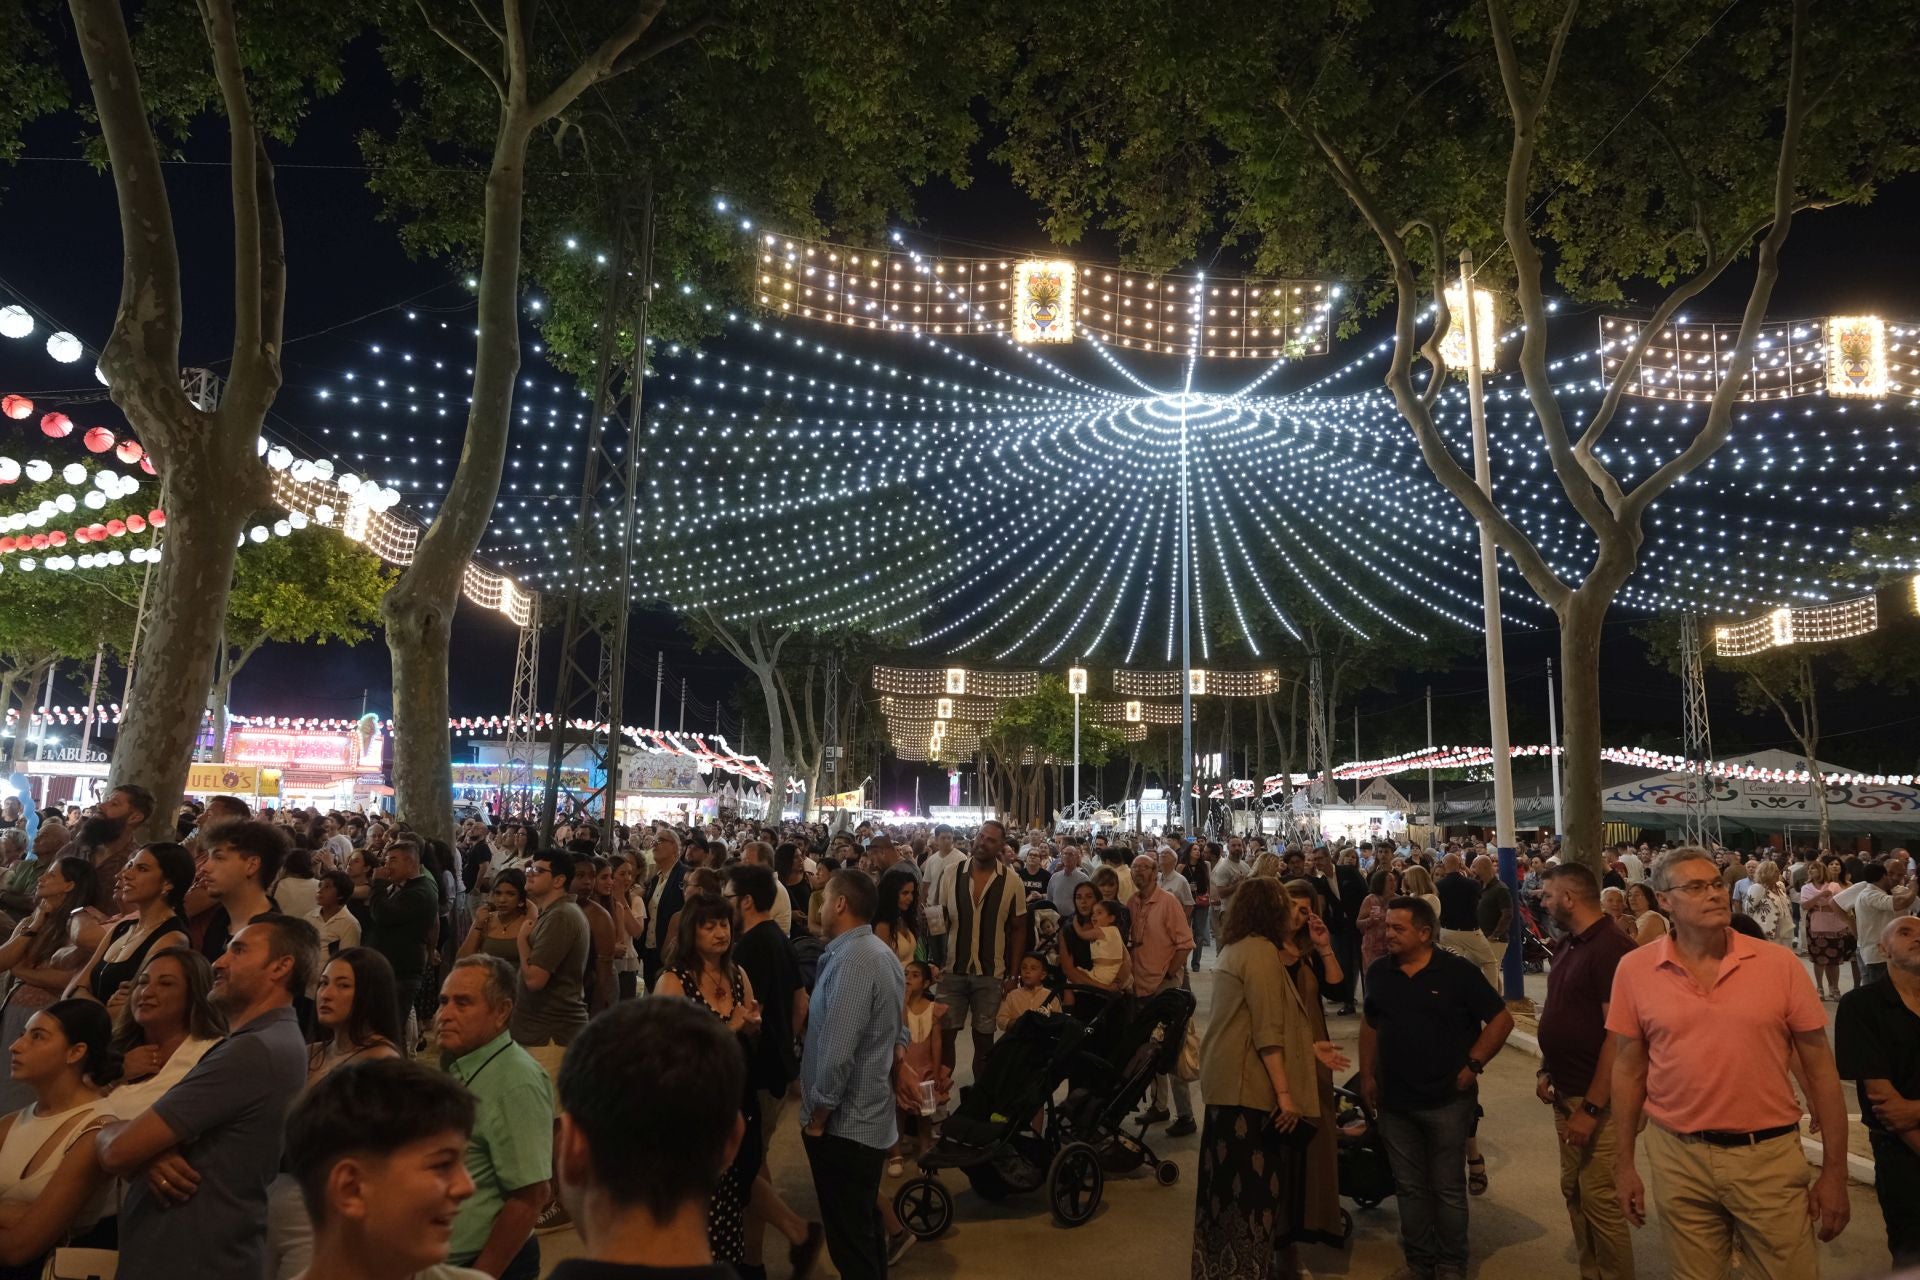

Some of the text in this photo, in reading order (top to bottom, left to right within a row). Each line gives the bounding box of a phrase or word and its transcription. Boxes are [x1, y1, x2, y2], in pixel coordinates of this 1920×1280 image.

[42, 747, 108, 762] EL ABUELO
[192, 770, 252, 788] UELOS
